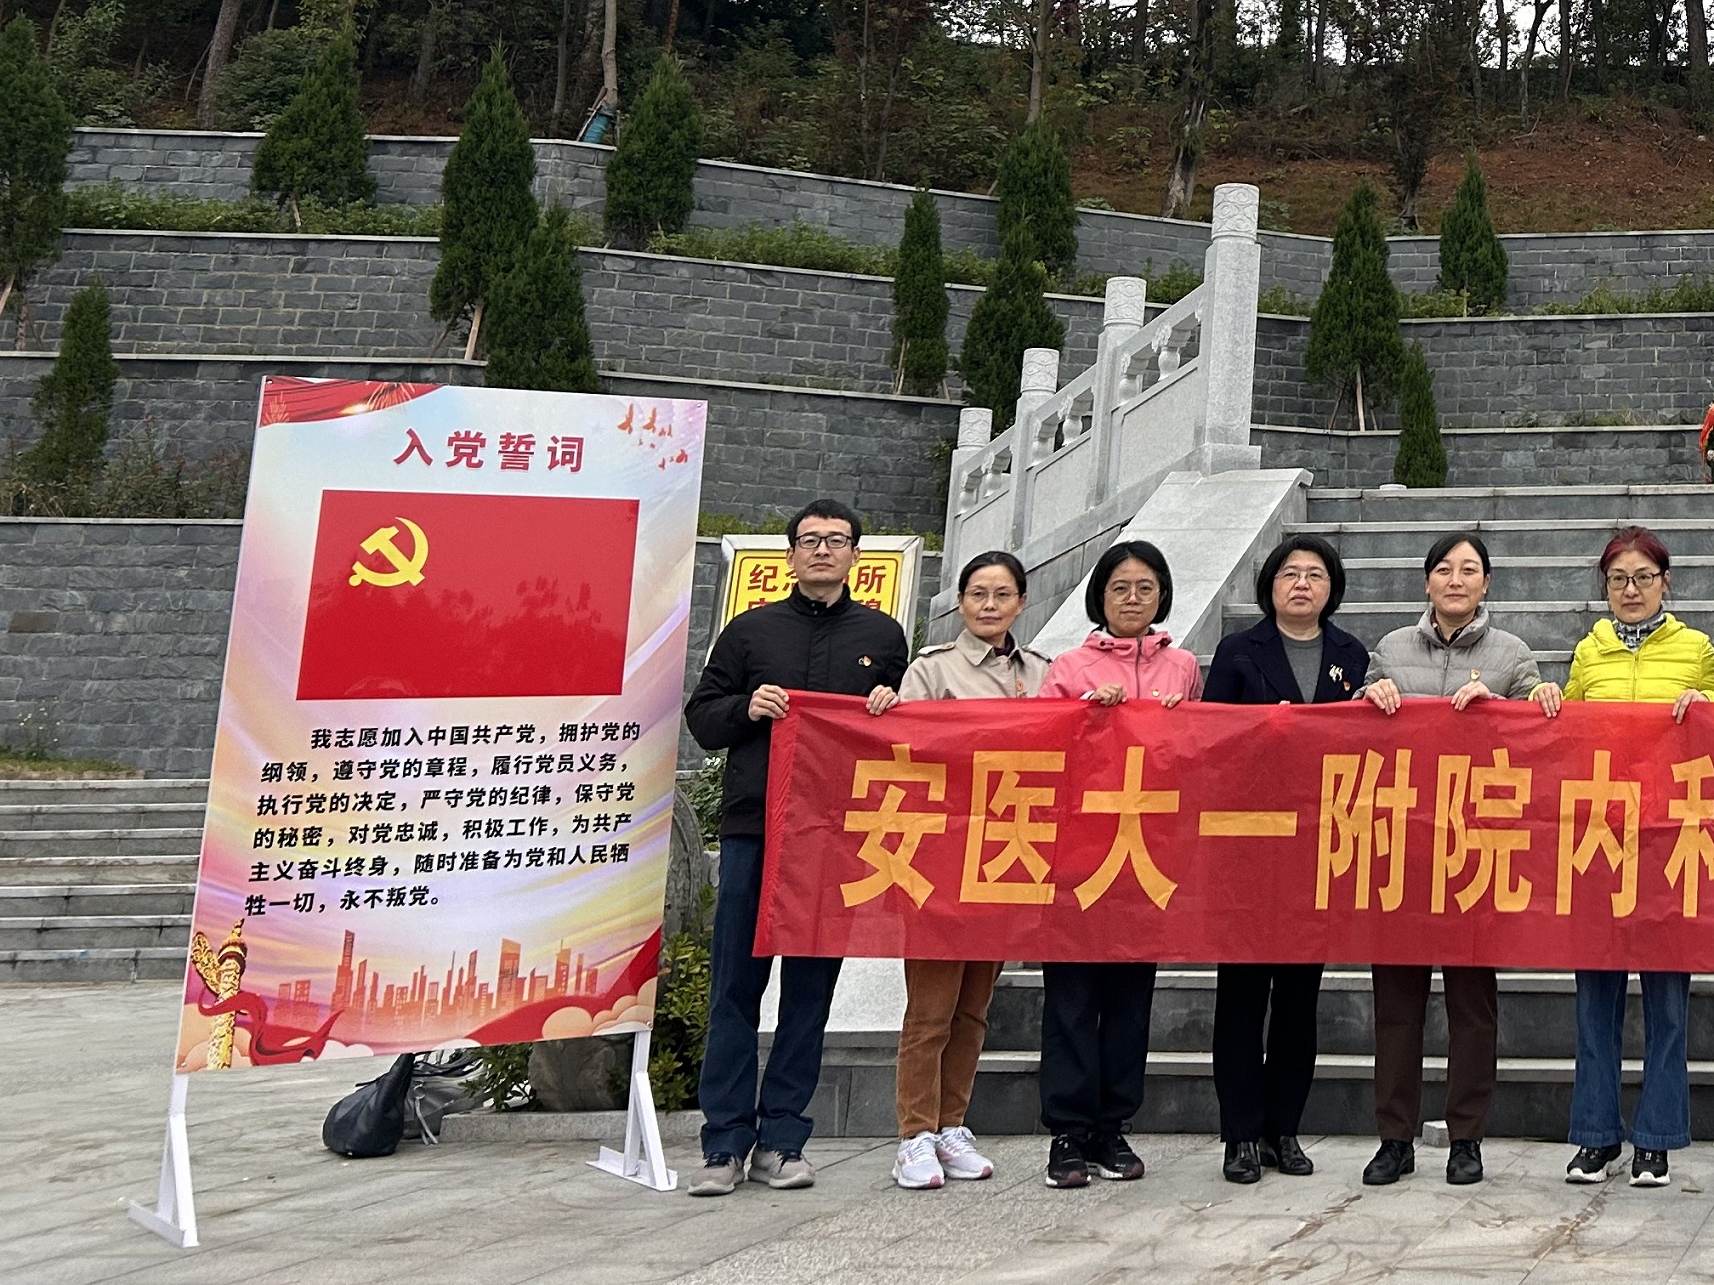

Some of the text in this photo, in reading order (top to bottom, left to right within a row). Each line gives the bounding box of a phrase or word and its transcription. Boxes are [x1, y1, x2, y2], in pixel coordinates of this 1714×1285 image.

[394, 429, 584, 473] 入党誓词
[310, 721, 641, 750] 我志愿加入中国共产党，拥护党的
[260, 752, 630, 783] 纲领，遵守党的章程，履行党员义务，
[256, 781, 635, 817] 执行党的决定，严守党的纪律，保守党
[252, 812, 632, 849] 的秘密，对党忠诚，积极工作，为共产
[248, 843, 630, 883] 主义奋斗终身，随时准备为党和人民牺
[244, 885, 441, 917] 牲一切，永不叛党。
